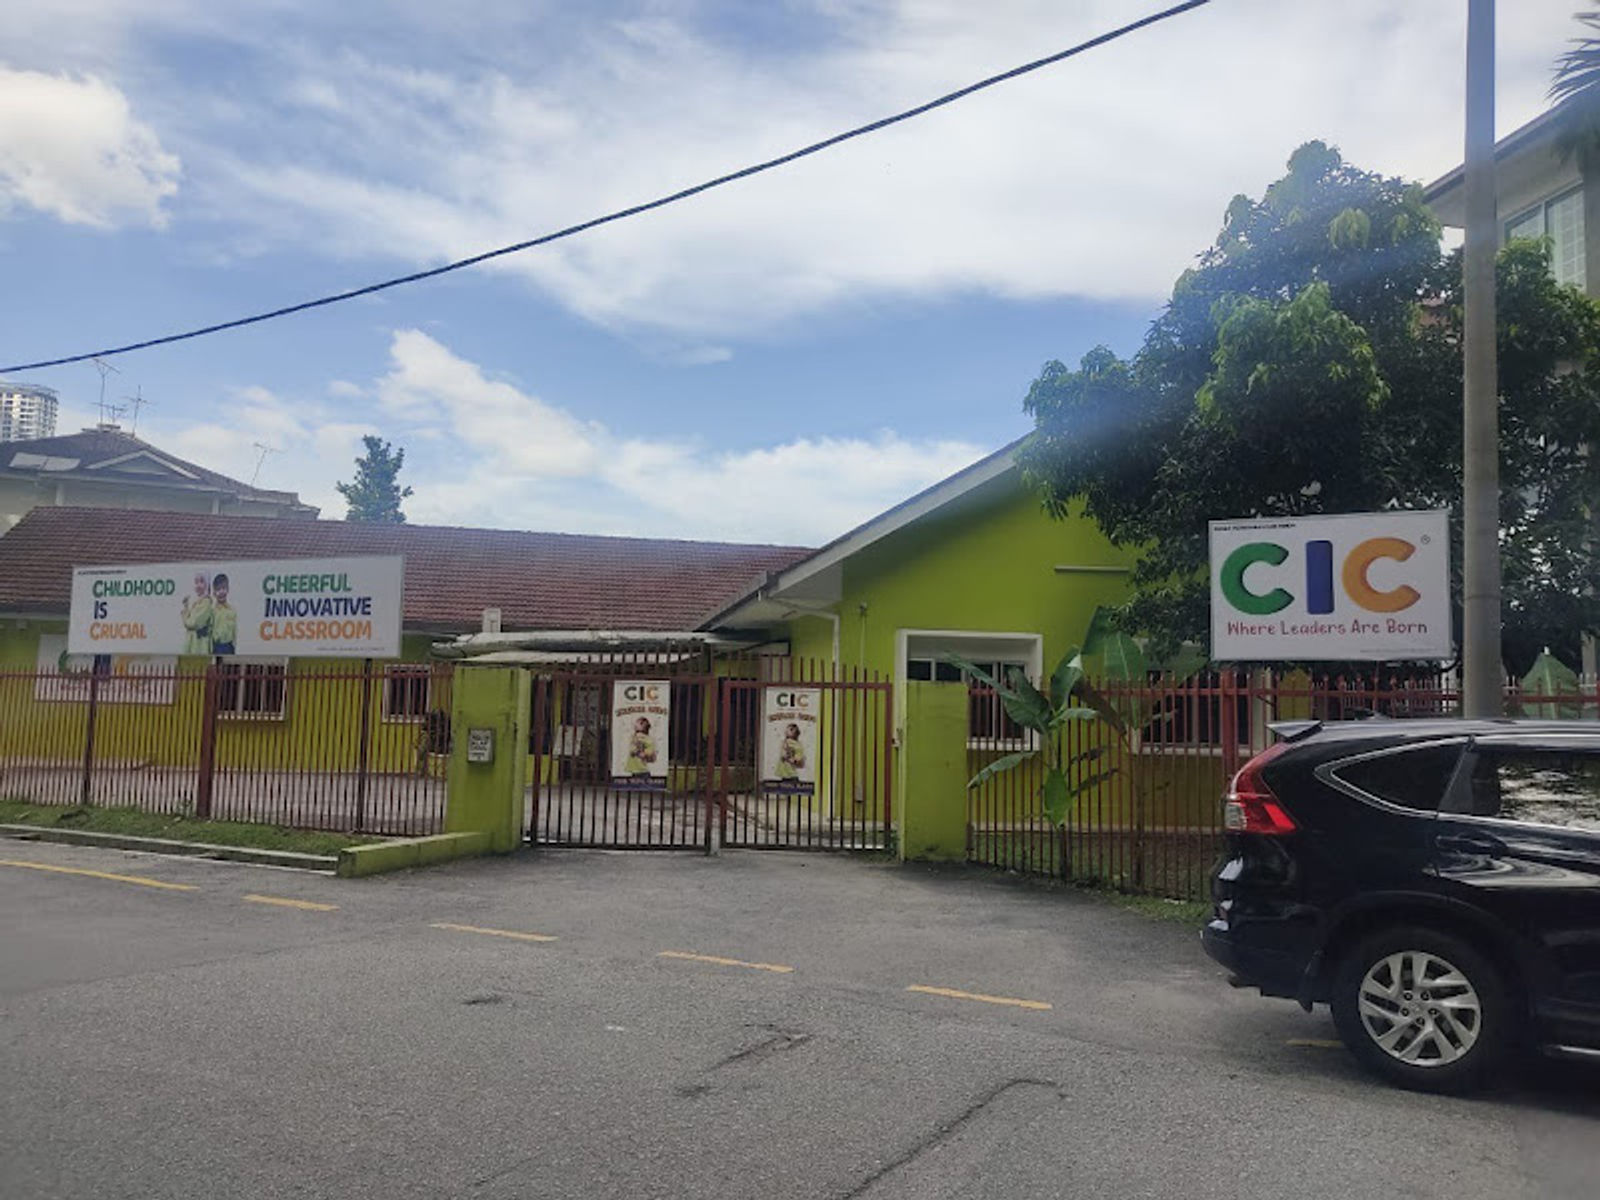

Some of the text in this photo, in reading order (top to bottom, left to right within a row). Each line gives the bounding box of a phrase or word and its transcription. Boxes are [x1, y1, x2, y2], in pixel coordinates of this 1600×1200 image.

[262, 573, 352, 595] CHEERFUL
[1220, 537, 1421, 615] CIC
[92, 579, 175, 598] CHILDHOOD
[94, 600, 108, 619] IS
[264, 596, 372, 618] INNOVATIVE
[89, 622, 147, 640] CRUCIAL
[259, 620, 372, 641] CLASSROOM
[1227, 618, 1428, 636] Where Leaders Are Born
[624, 685, 659, 701] CIC
[776, 693, 809, 707] CIC
